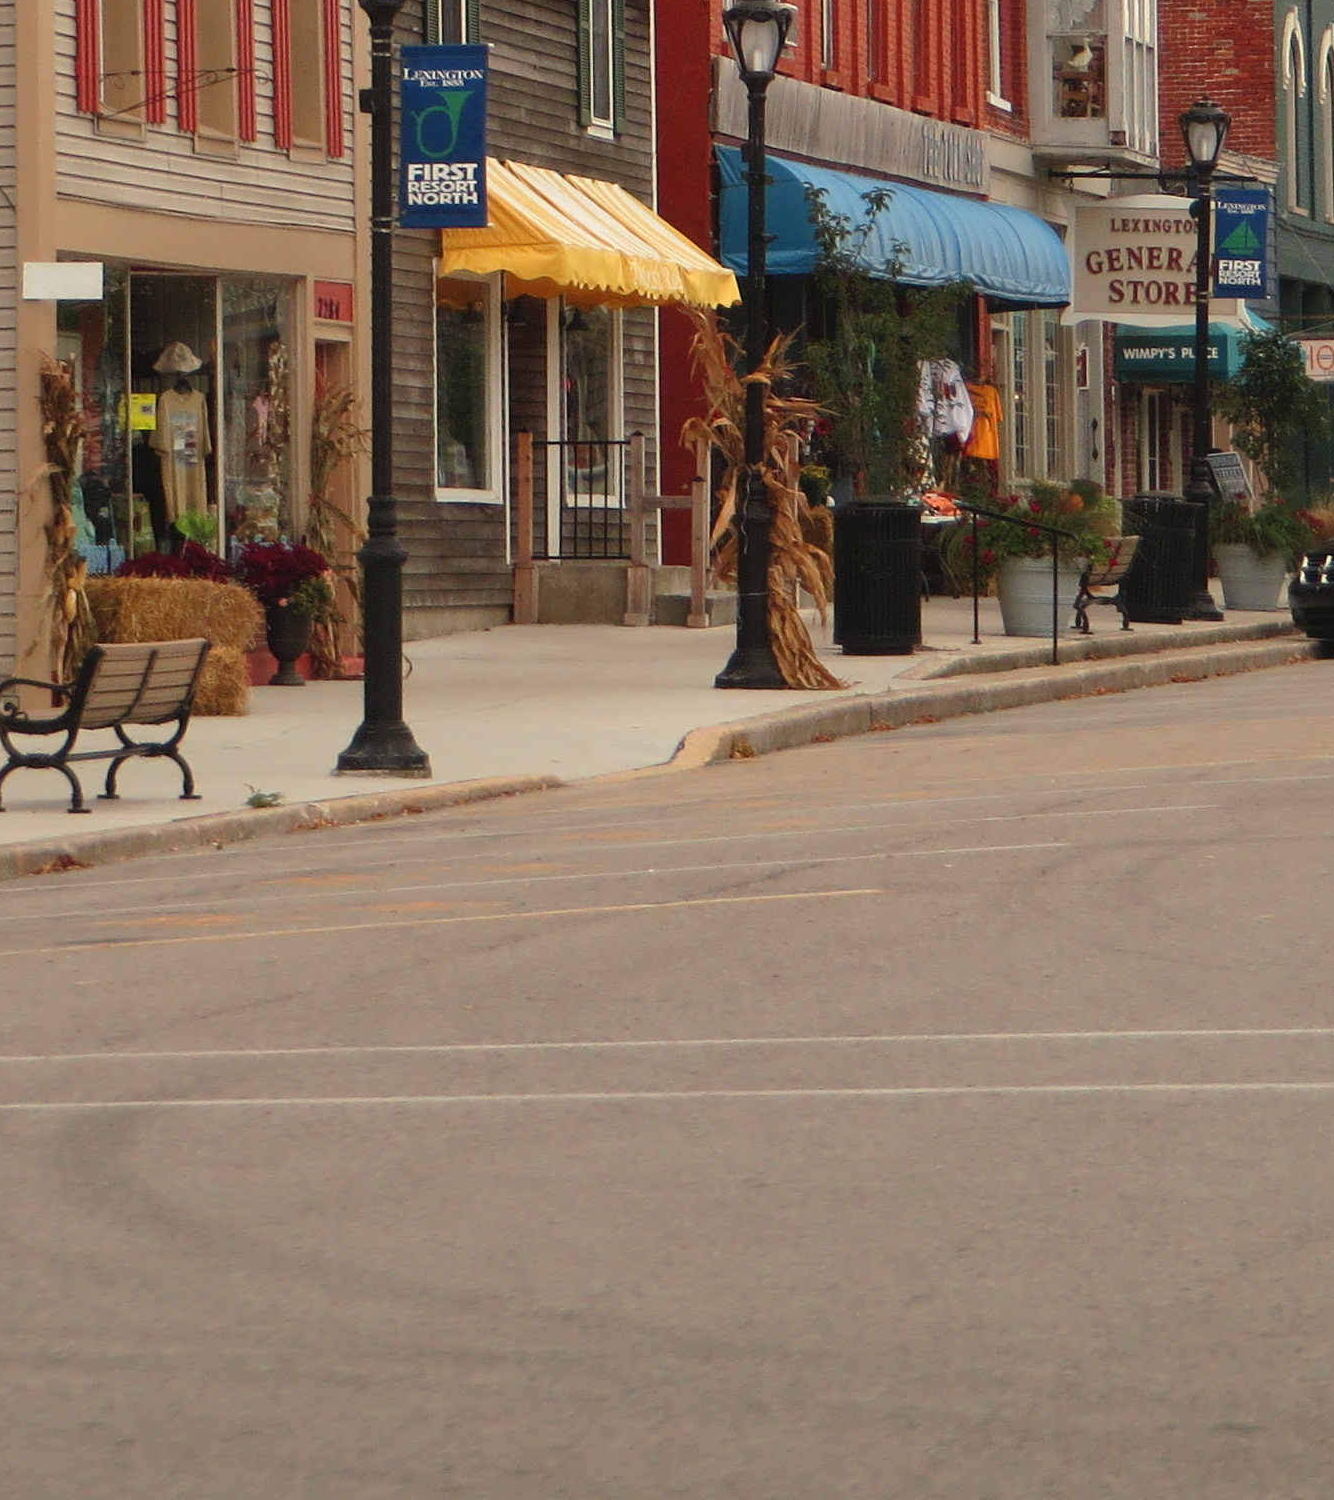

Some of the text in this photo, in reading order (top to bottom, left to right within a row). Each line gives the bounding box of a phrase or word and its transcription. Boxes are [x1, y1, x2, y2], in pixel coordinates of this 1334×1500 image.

[407, 163, 478, 181] FIRST
[407, 181, 478, 193] RESORT
[407, 192, 478, 205] NORTH
[1085, 246, 1199, 275] GENERA
[1218, 259, 1262, 271] FIRST
[1218, 277, 1262, 286] NORTH
[1108, 279, 1198, 305] STORE
[1122, 347, 1177, 360] WIMPY'S
